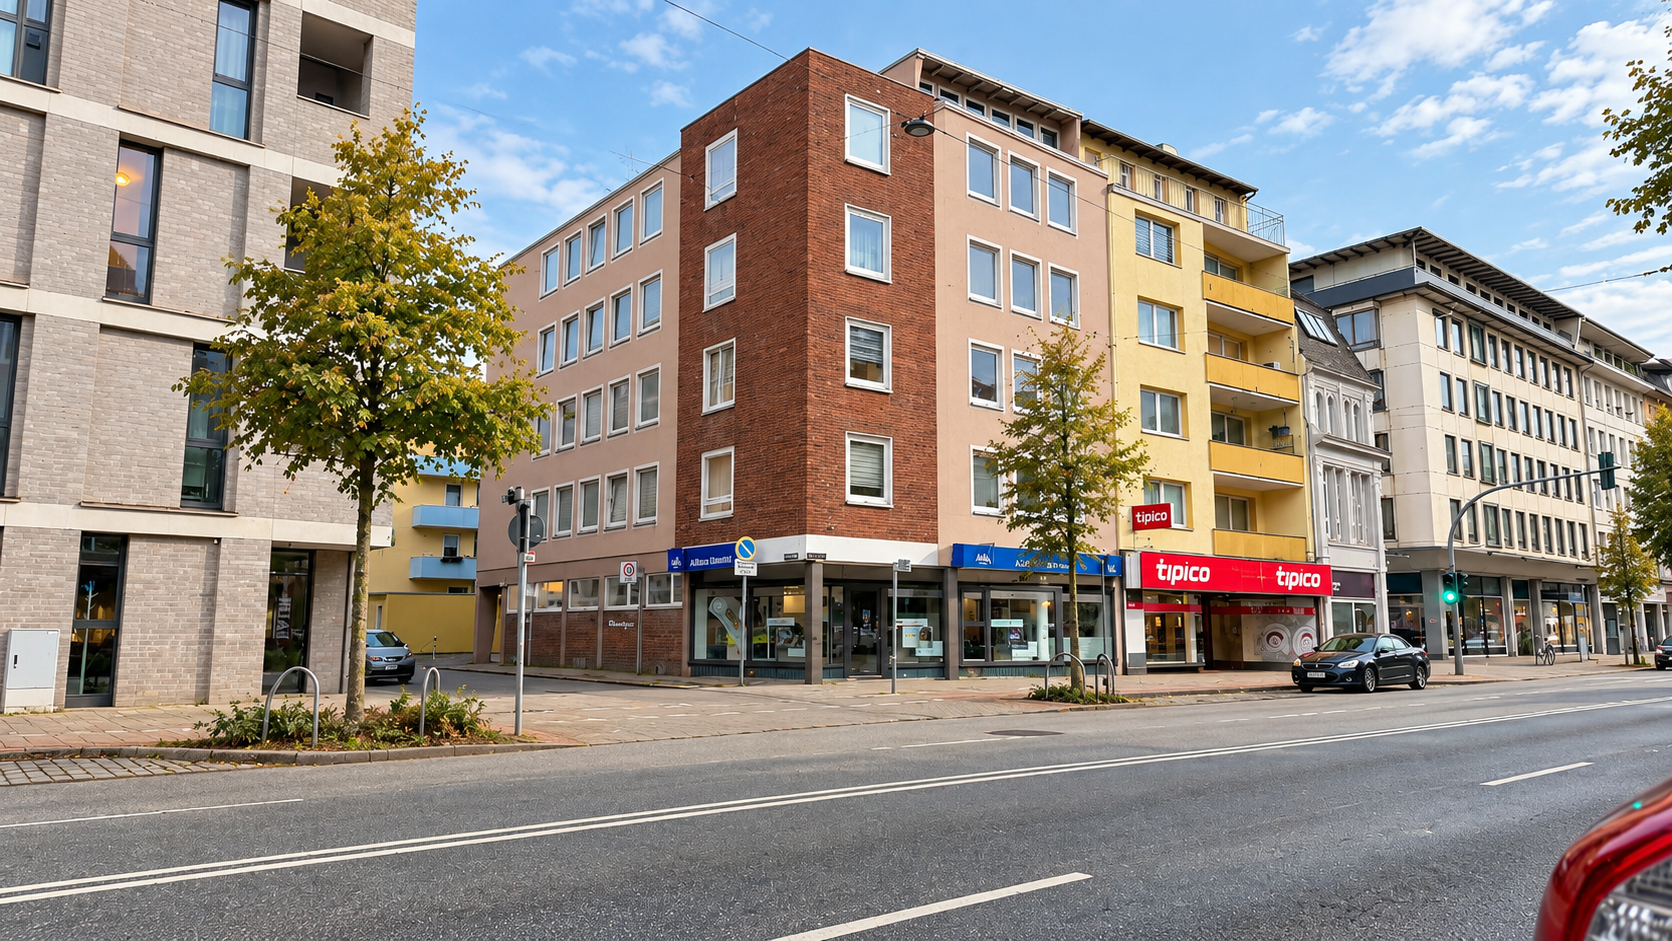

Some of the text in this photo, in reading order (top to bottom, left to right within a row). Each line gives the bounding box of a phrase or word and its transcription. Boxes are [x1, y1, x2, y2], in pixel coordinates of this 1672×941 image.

[1135, 511, 1168, 525] tipico
[1156, 558, 1210, 585] tipico
[1276, 566, 1320, 590] tipico
